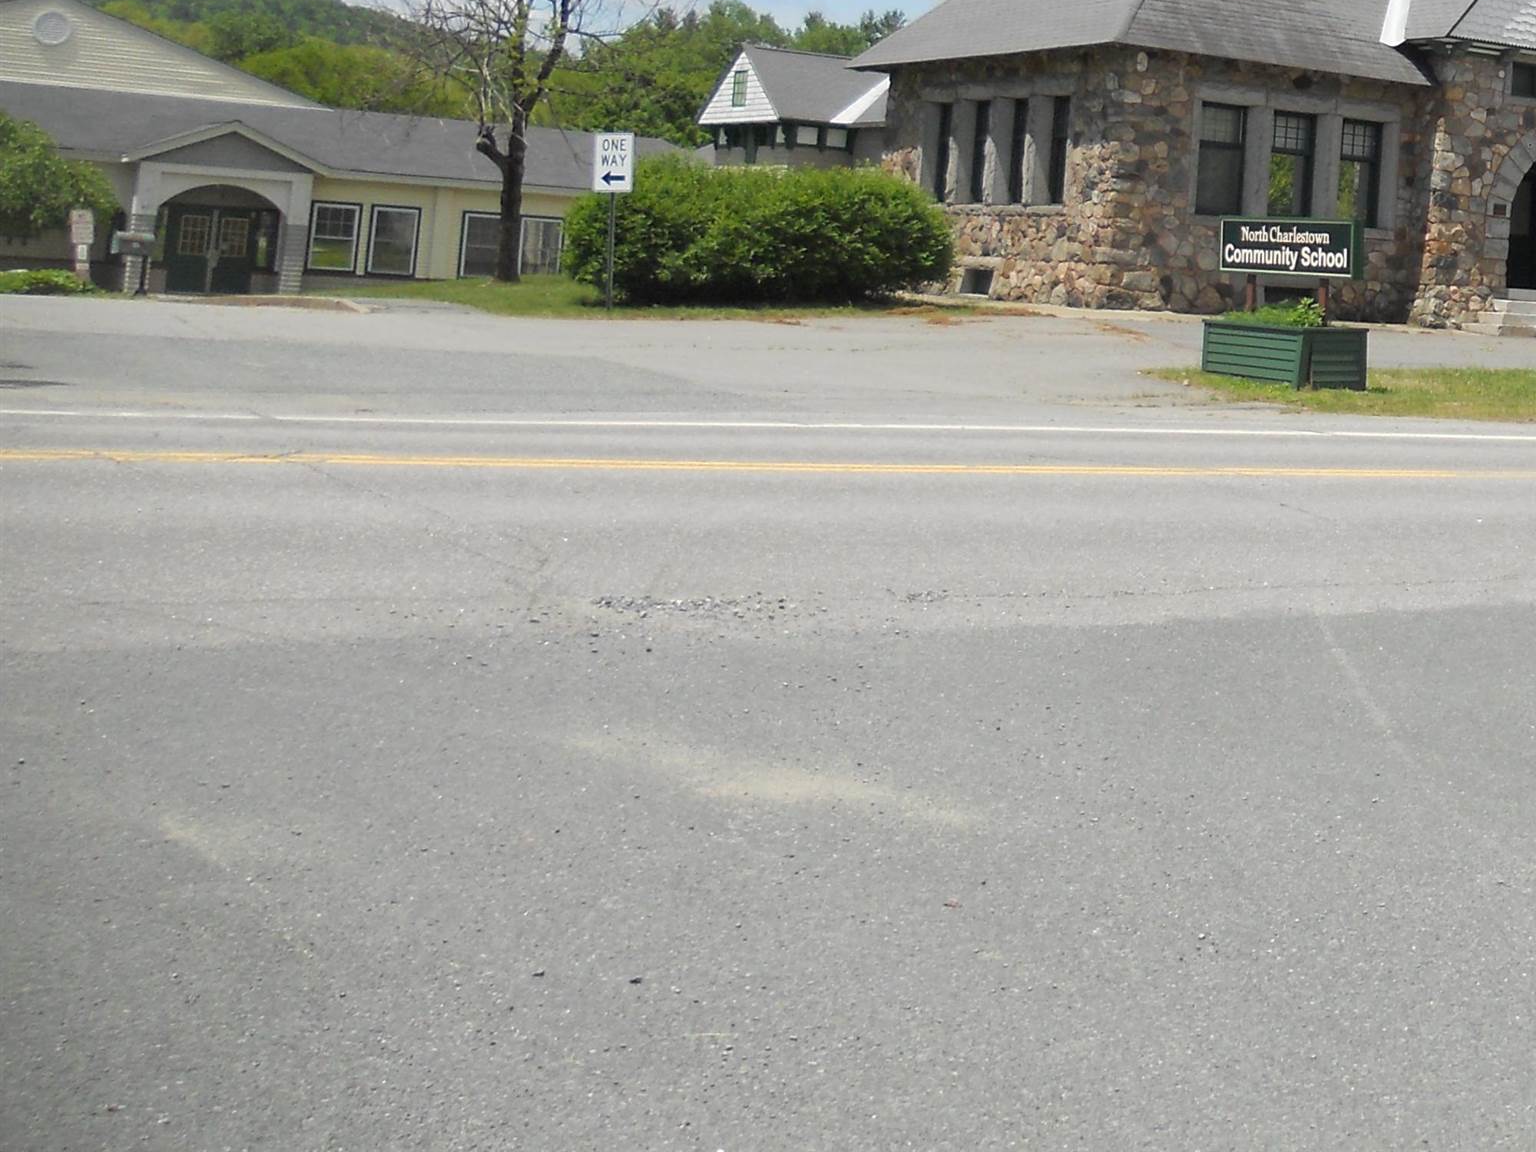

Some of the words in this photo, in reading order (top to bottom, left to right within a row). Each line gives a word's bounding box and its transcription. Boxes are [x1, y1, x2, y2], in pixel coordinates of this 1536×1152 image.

[602, 138, 627, 152] ONE
[601, 154, 627, 167] WAY
[1241, 225, 1268, 242] North
[1269, 225, 1330, 245] Charlestown
[1225, 243, 1298, 270] Community
[1300, 246, 1348, 268] School
